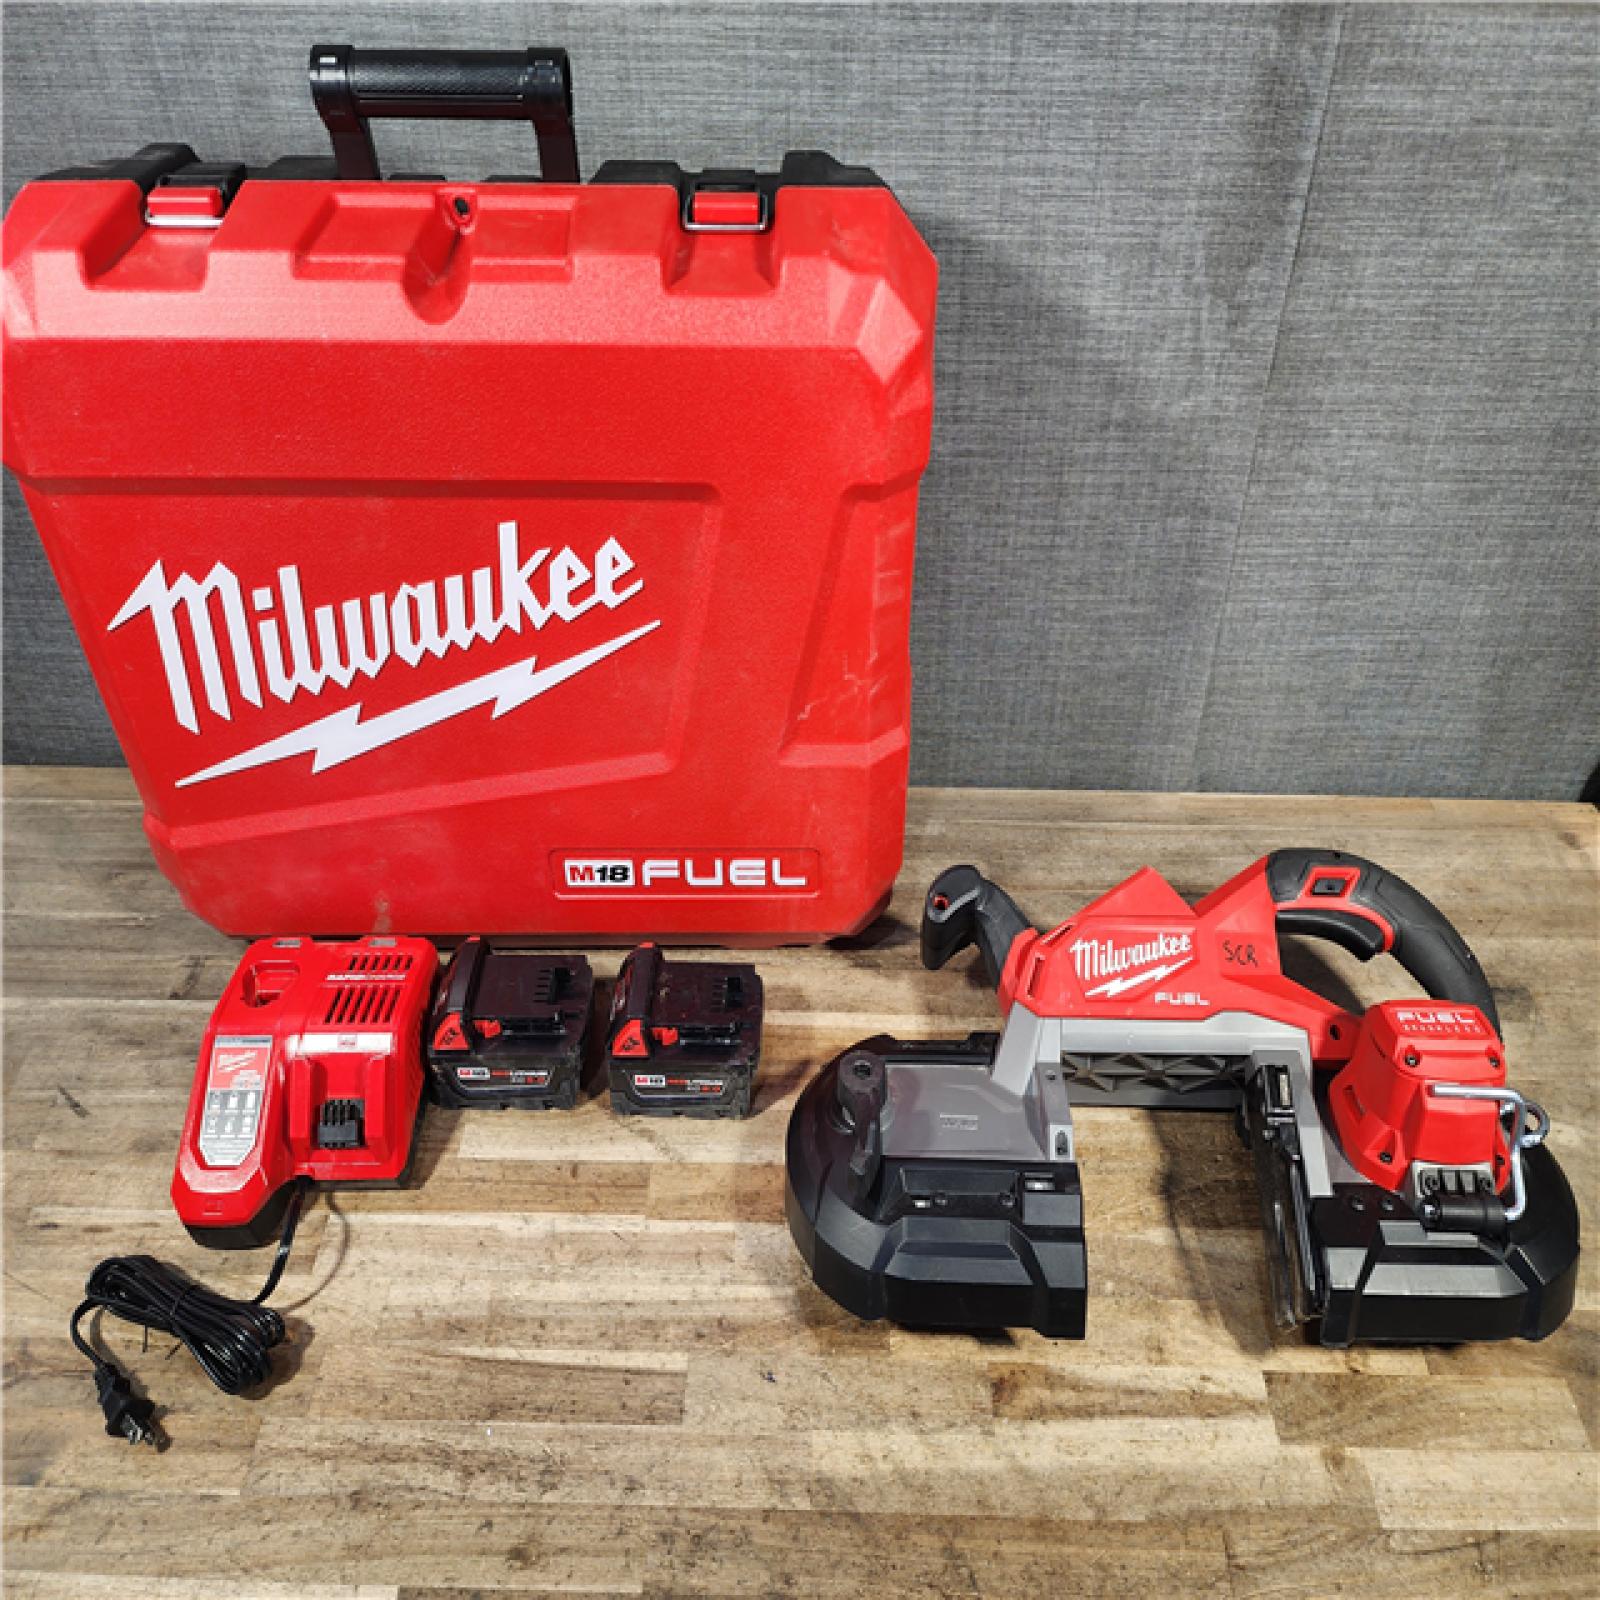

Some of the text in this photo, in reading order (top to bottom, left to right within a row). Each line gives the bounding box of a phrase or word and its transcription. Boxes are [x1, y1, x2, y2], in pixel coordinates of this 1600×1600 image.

[107, 520, 644, 735] Milwaukee
[569, 858, 807, 886] M18 FUEL
[1070, 931, 1193, 981] Milwaukee
[1154, 991, 1210, 1006] FUEL
[1397, 1010, 1476, 1024] FUEL
